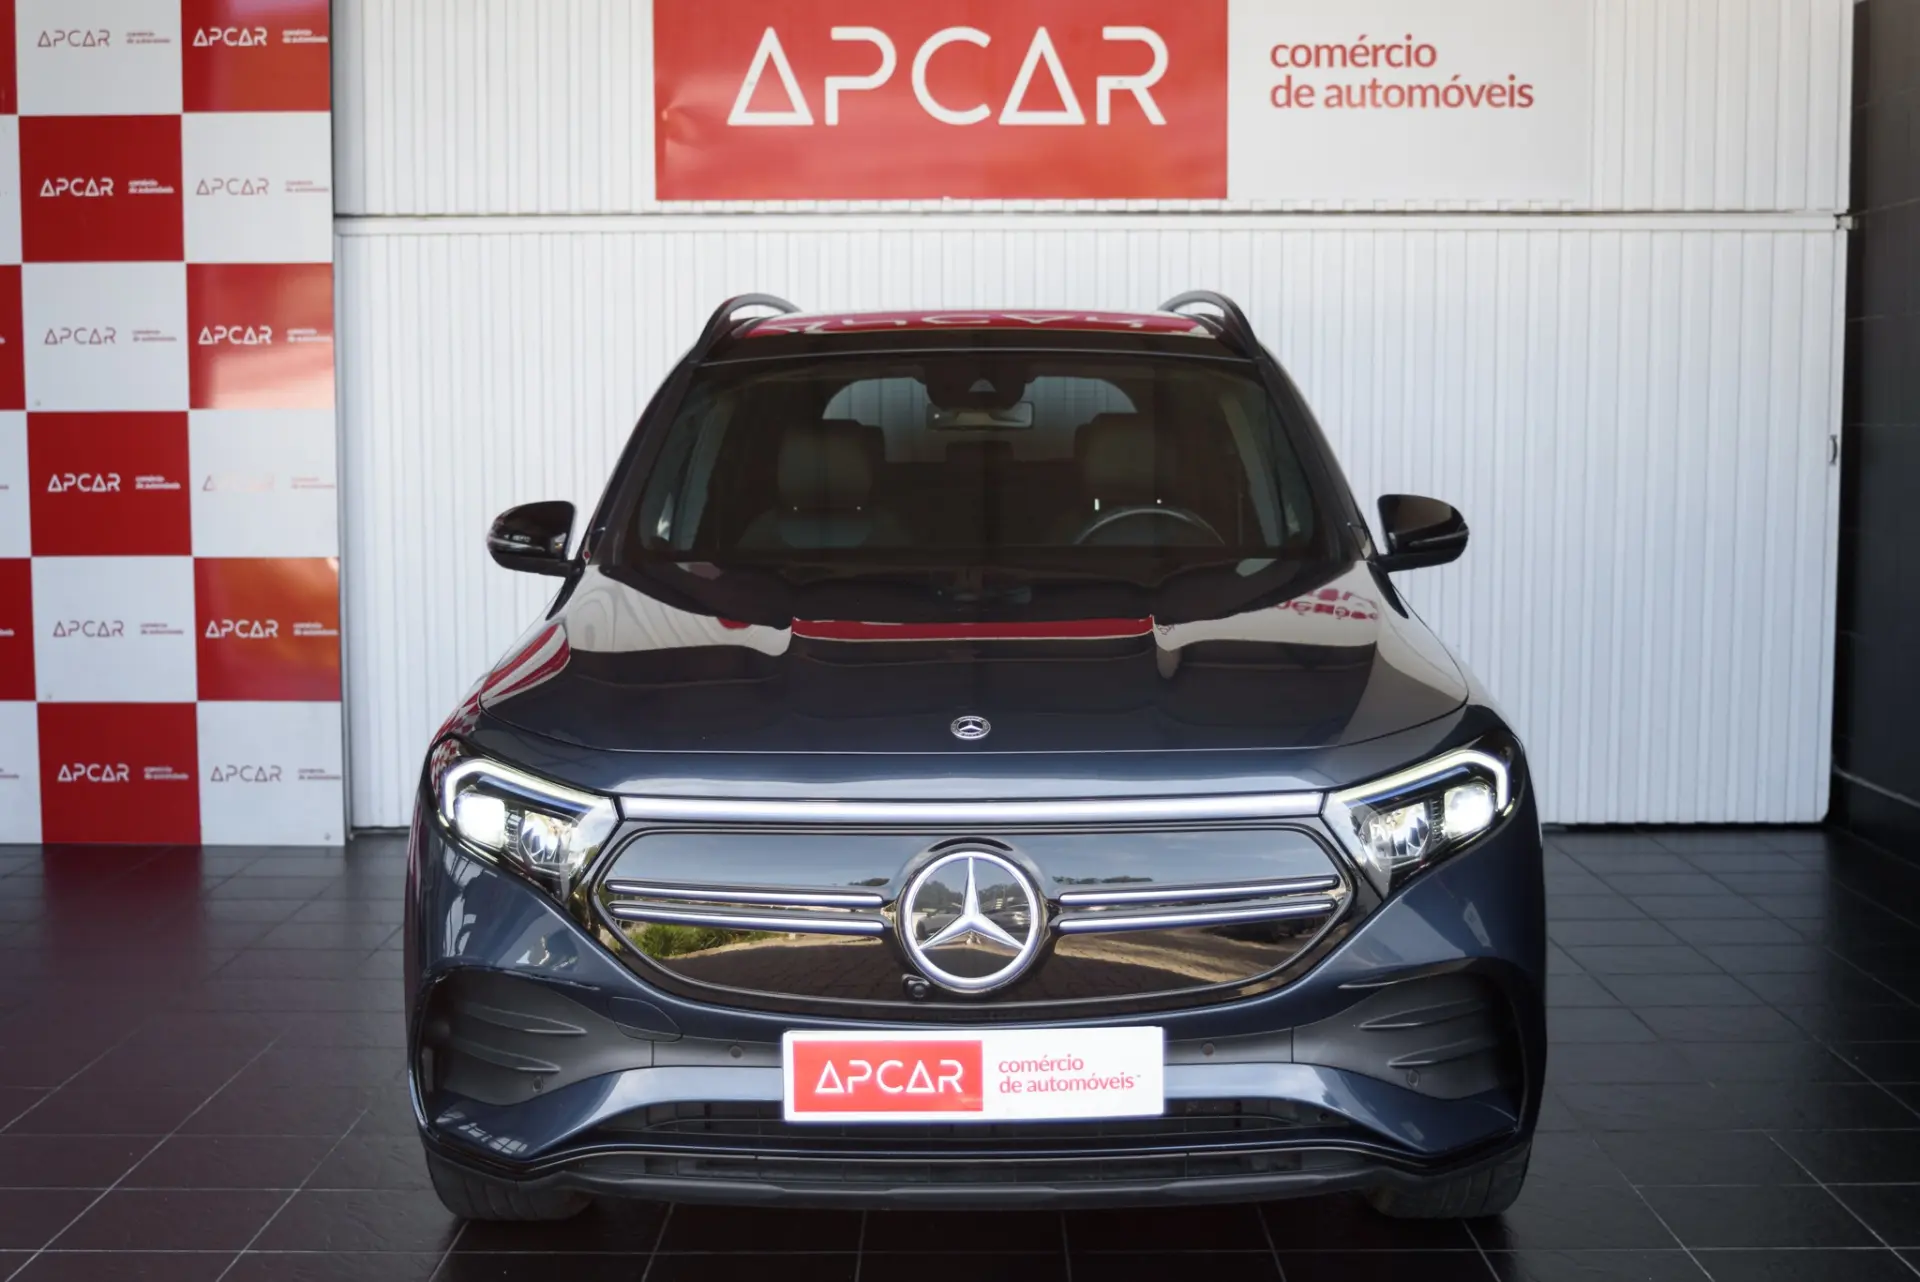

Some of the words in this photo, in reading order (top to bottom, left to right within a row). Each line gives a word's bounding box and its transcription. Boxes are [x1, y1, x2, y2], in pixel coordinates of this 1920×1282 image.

[37, 29, 110, 48] APCAR
[192, 27, 267, 47] APCAR
[1270, 33, 1437, 68] comércio
[727, 26, 1168, 126] APCAR
[1270, 74, 1315, 108] de
[1323, 74, 1534, 108] automóveis
[40, 177, 114, 197] APCAR
[196, 178, 270, 196] APCAR
[44, 327, 116, 345] APCAR
[198, 325, 272, 345] APCAR
[48, 473, 121, 492] APCAR
[52, 620, 124, 638] APCAR
[205, 619, 279, 638] APCAR
[57, 763, 130, 782] APCAR
[210, 765, 282, 783] APCAR
[998, 1053, 1084, 1073] comércio
[814, 1059, 964, 1094] APCAR
[999, 1075, 1022, 1093] de
[1026, 1071, 1134, 1093] automóveis
